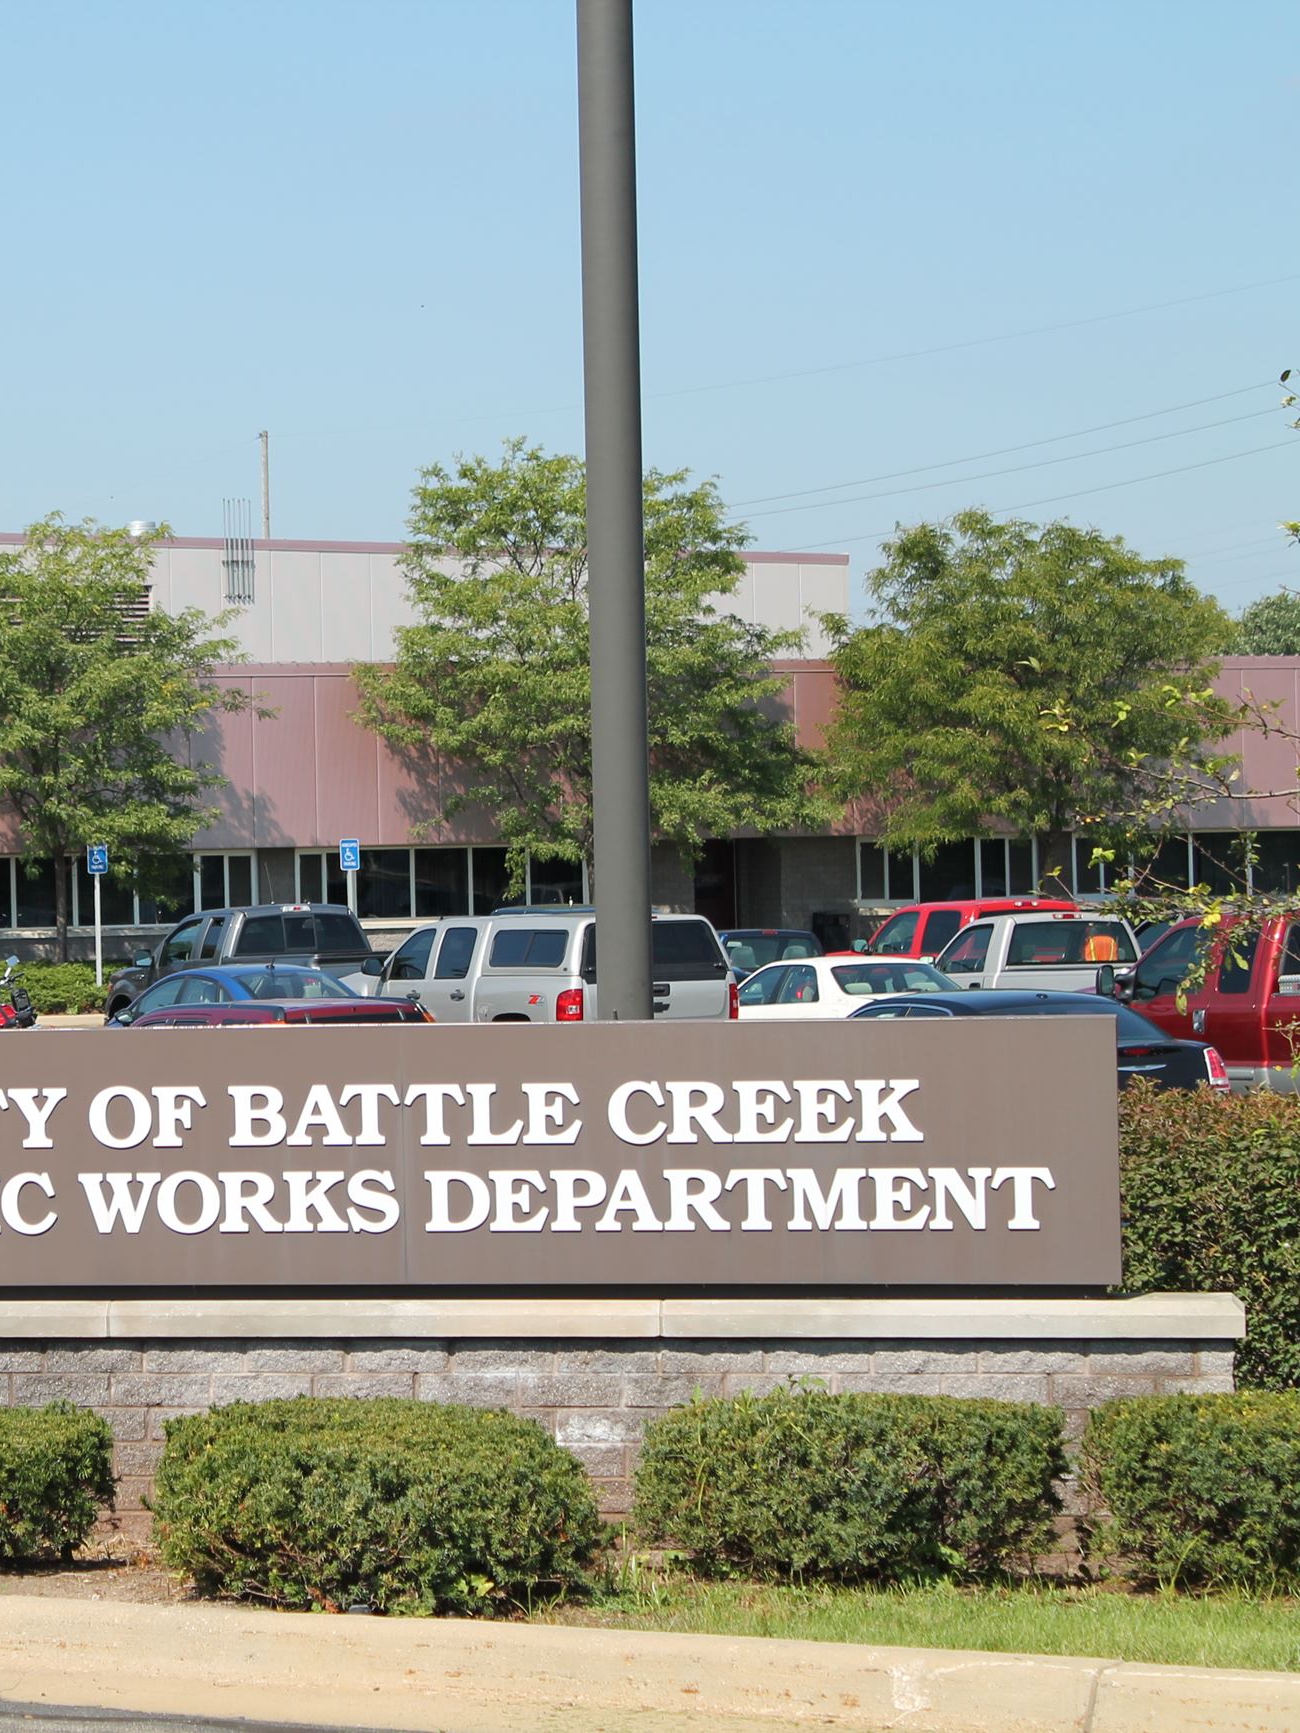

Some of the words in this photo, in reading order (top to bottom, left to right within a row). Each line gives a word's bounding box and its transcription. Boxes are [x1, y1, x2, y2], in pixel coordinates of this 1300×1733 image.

[87, 1085, 207, 1149] OF
[226, 1082, 583, 1149] BATTLE
[606, 1079, 924, 1146] CREEK
[77, 1169, 400, 1235] WORKS
[423, 1166, 1056, 1233] DEPARTMENT
